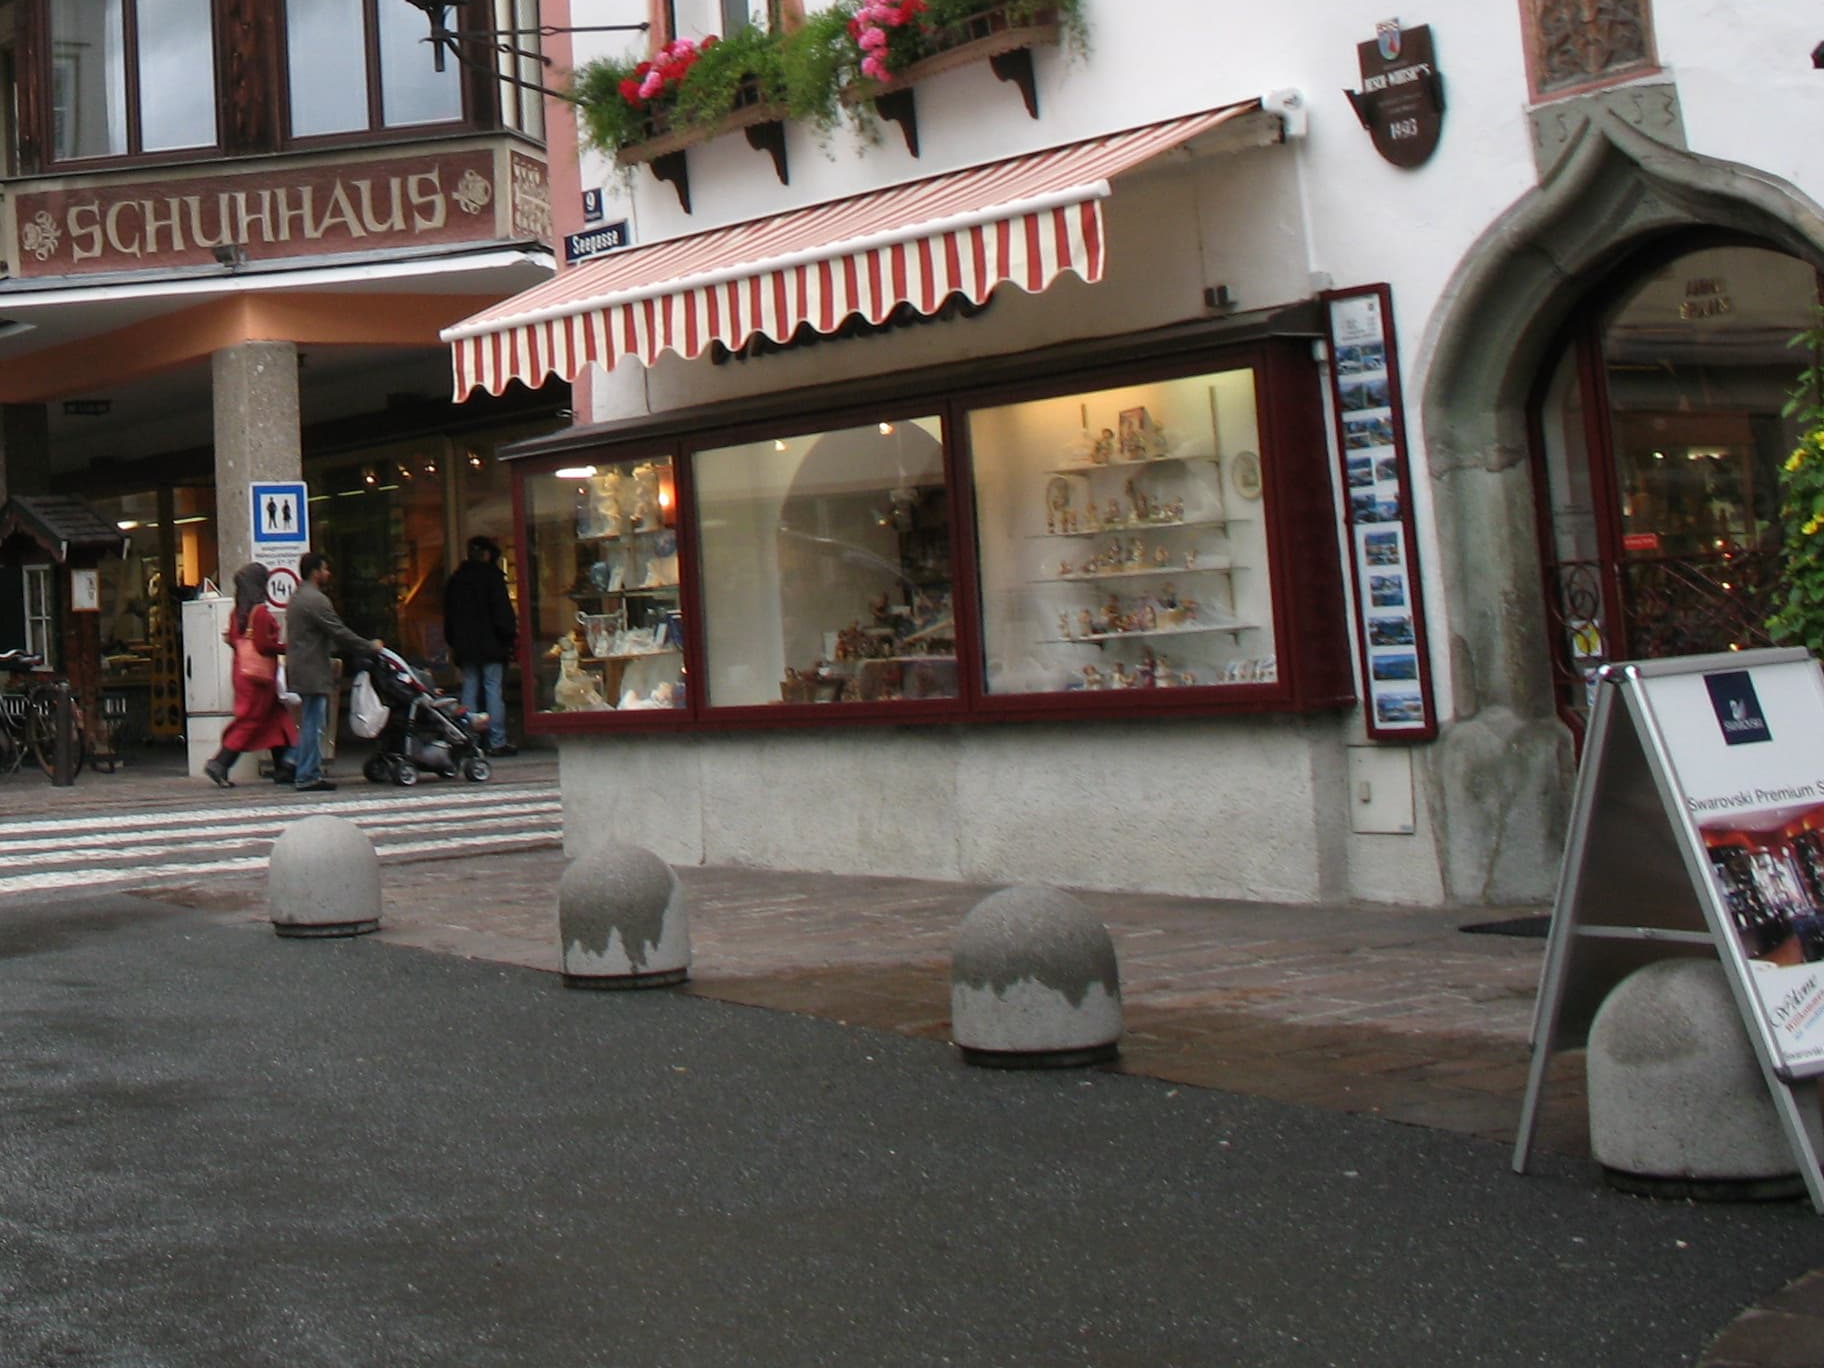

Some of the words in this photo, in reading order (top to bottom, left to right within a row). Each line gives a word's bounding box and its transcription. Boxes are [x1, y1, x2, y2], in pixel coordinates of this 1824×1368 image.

[66, 167, 446, 263] SCHUHHAUS
[586, 191, 596, 211] 9
[572, 230, 619, 255] Seegasse
[1687, 791, 1754, 813] Swarovski
[1756, 782, 1815, 804] Premium
